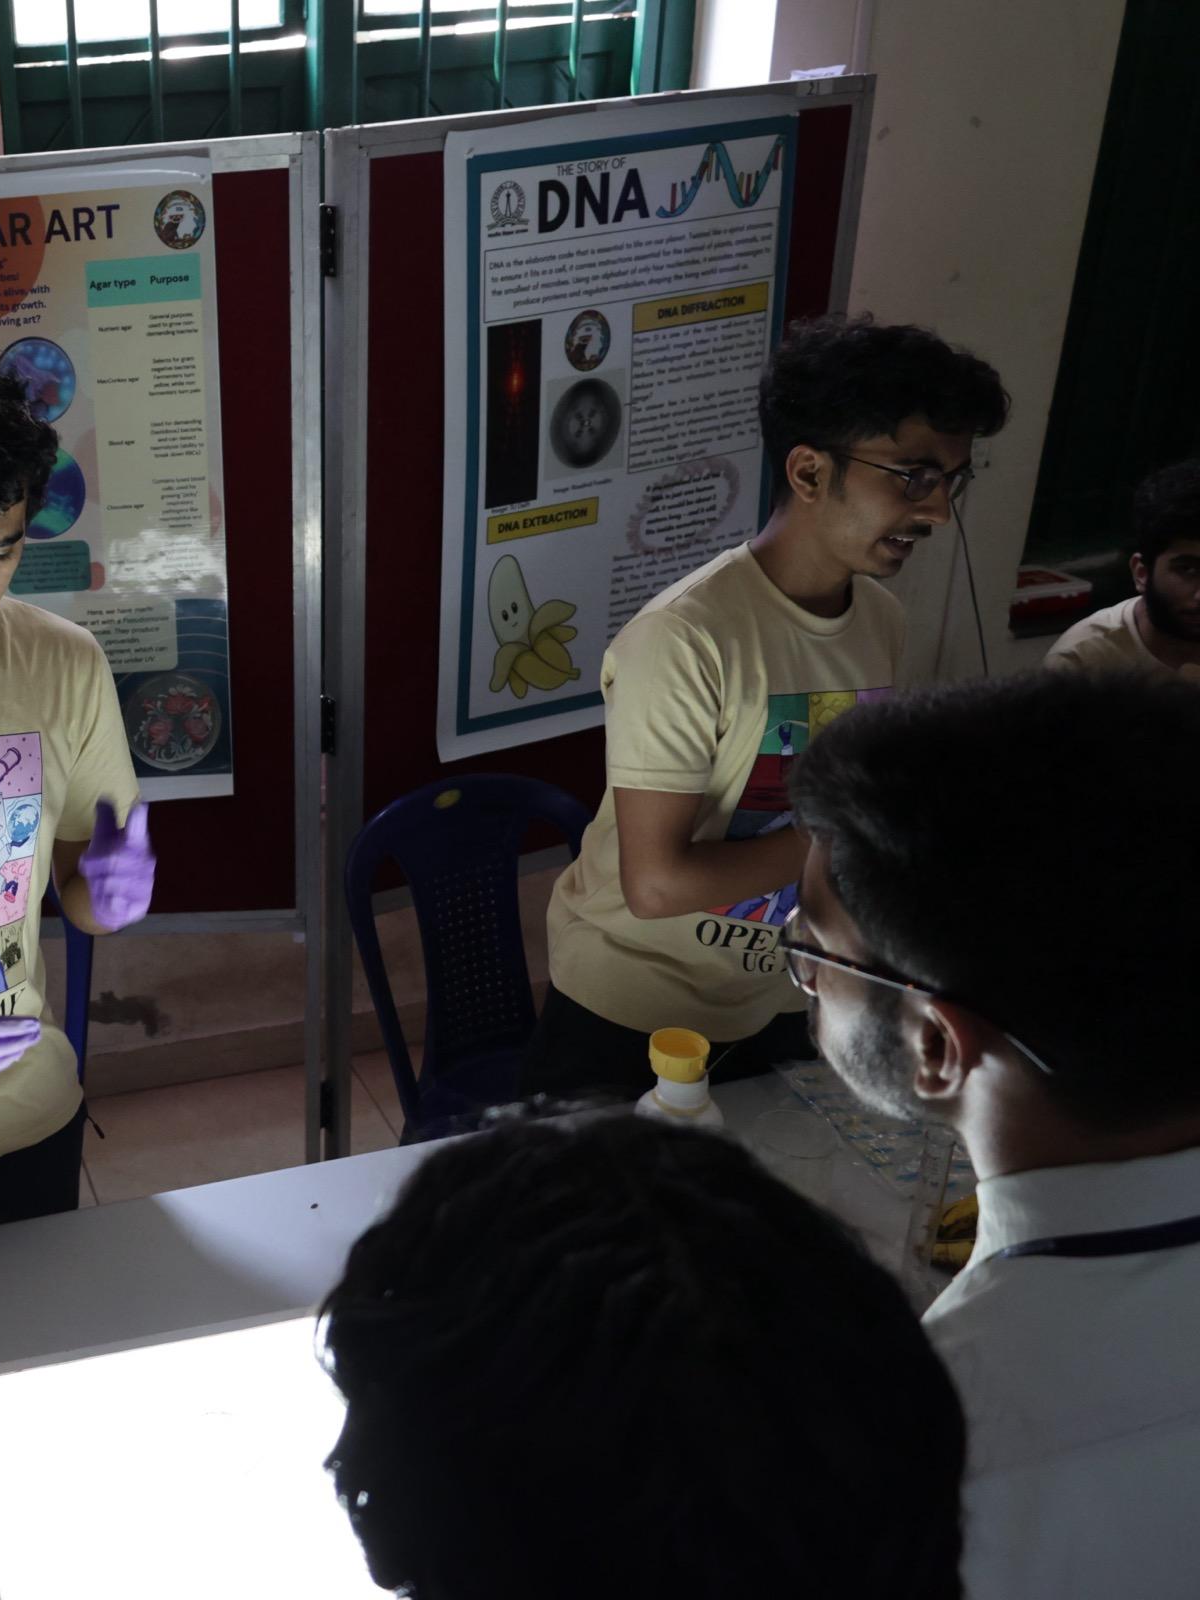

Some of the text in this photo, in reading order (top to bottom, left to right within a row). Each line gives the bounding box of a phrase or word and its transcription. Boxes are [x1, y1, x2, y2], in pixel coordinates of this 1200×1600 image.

[556, 156, 626, 176] THE STORY OF
[538, 168, 650, 234] DNA
[45, 204, 120, 244] ART
[489, 260, 503, 270] DNA
[30, 284, 50, 293] with
[90, 277, 136, 291] Agar type
[150, 272, 189, 286] Purpose
[10, 298, 46, 312] growth.
[658, 296, 744, 320] DNA DIFFRACTION
[22, 313, 41, 323] art?
[498, 518, 520, 533] DNA
[522, 507, 587, 528] EXTRACTION
[696, 919, 779, 954] OPE
[742, 952, 776, 973] UG
